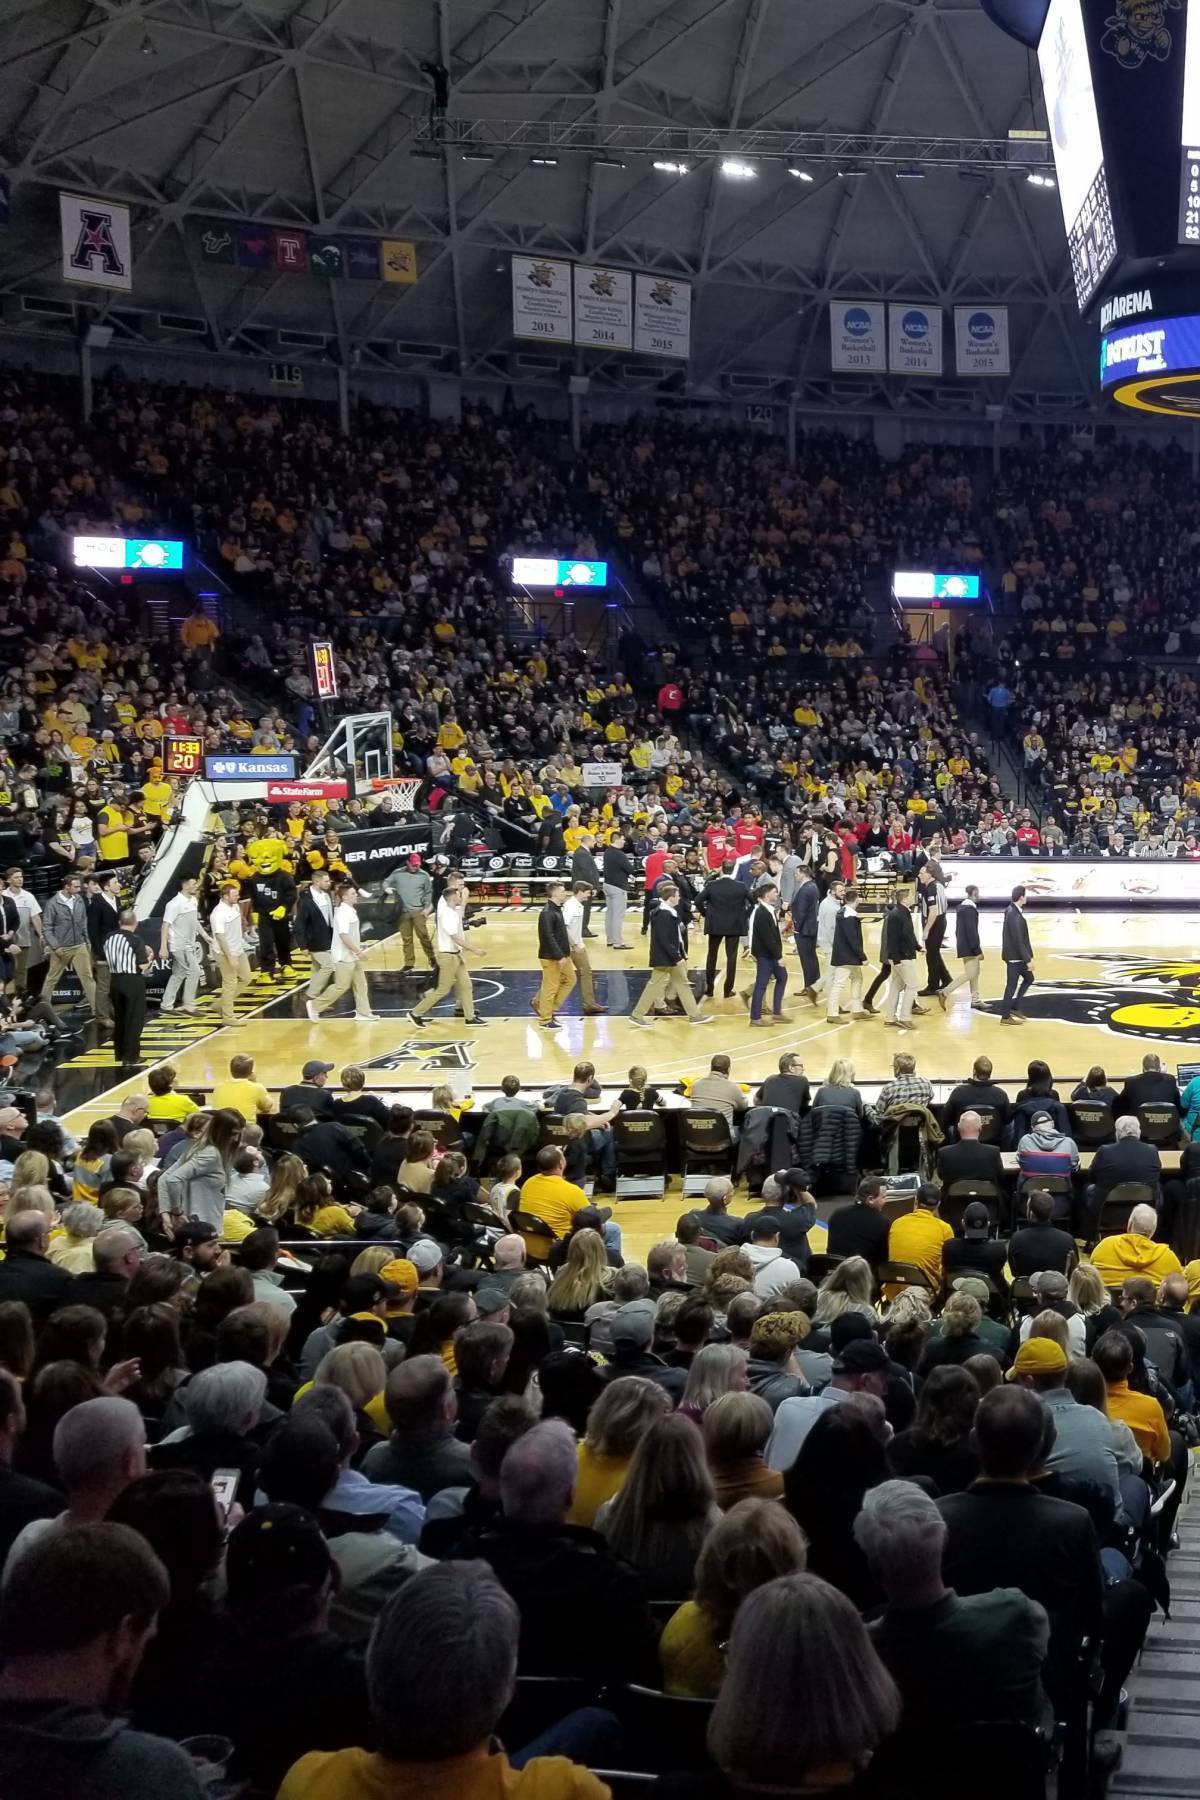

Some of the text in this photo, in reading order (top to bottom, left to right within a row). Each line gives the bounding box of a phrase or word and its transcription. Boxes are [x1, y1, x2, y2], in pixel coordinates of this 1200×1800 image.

[1191, 165, 1199, 176] 0
[1187, 196, 1200, 208] 10
[1186, 211, 1199, 223] 21
[71, 209, 125, 276] A
[1112, 290, 1152, 319] ARENA
[532, 321, 554, 332] 2013
[904, 324, 928, 332] NCAA
[971, 325, 994, 333] NCAA
[592, 330, 614, 341] 2014
[651, 338, 672, 349] 2015
[973, 358, 994, 367] 2015
[746, 405, 773, 422] 120
[172, 742, 200, 754] 11:33
[173, 754, 193, 769] 20
[238, 762, 288, 772] Kansas
[369, 842, 429, 859] ARMOUR
[769, 842, 775, 851] 2
[256, 883, 278, 900] WSU
